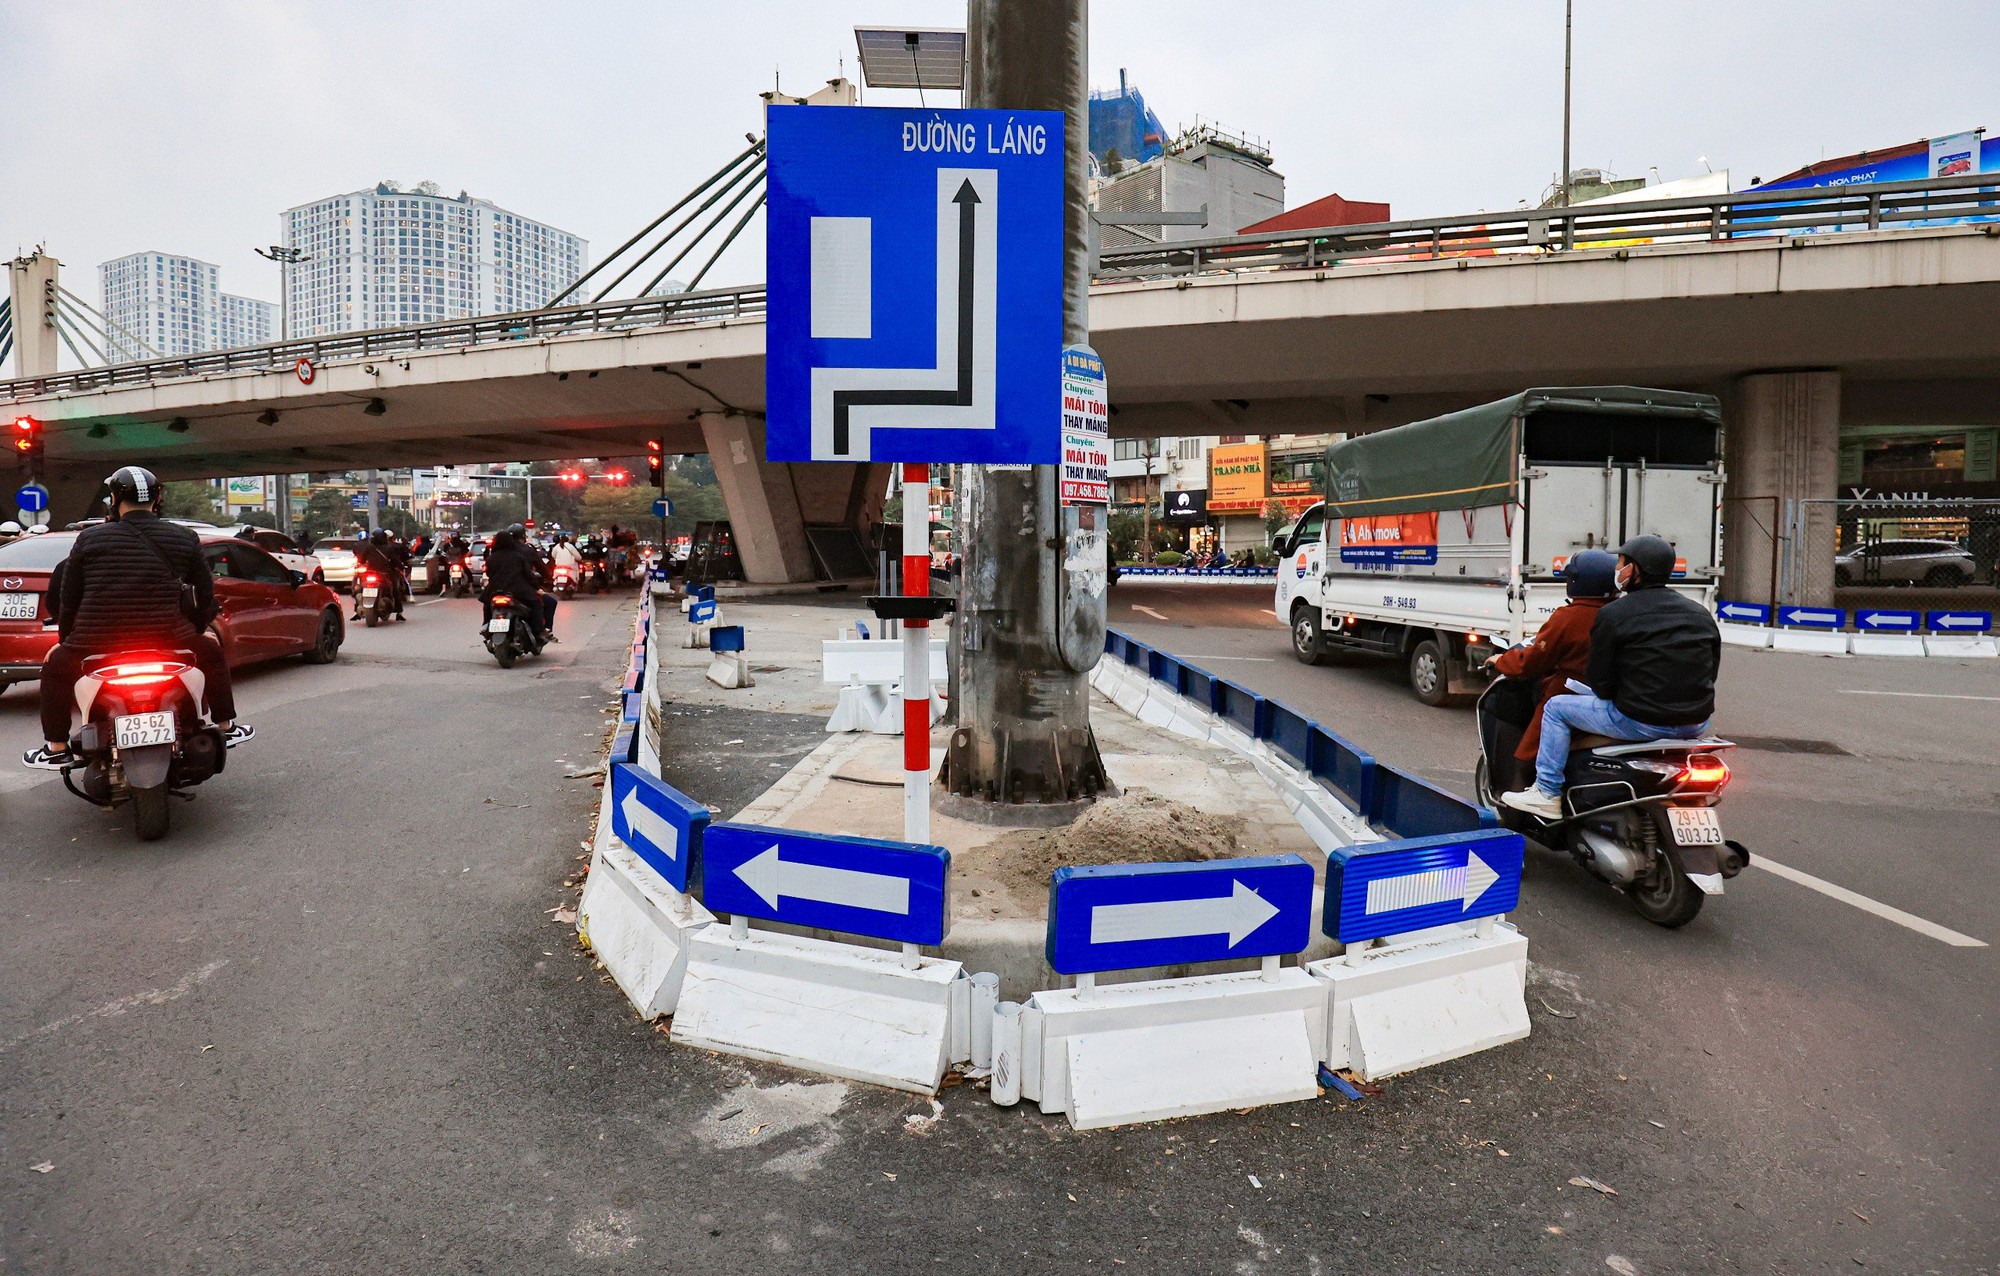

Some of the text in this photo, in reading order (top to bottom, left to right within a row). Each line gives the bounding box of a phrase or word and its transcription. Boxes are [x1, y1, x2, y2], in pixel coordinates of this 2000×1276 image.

[902, 113, 1046, 155] ĐƯỜNG LÁNG
[1064, 396, 1107, 416] MÁI TÔN
[1064, 414, 1107, 433] THAY MÁNG
[1066, 448, 1107, 466] MÁI TÔN
[1065, 465, 1084, 480] THAY
[1214, 465, 1241, 476] TRANG
[5, 593, 29, 606] 30E
[2, 606, 36, 618] 40.69
[125, 714, 166, 732] 29-G2
[121, 727, 171, 746] 002.72
[1676, 810, 1711, 826] 29-L1
[1677, 827, 1721, 843] 903.23
